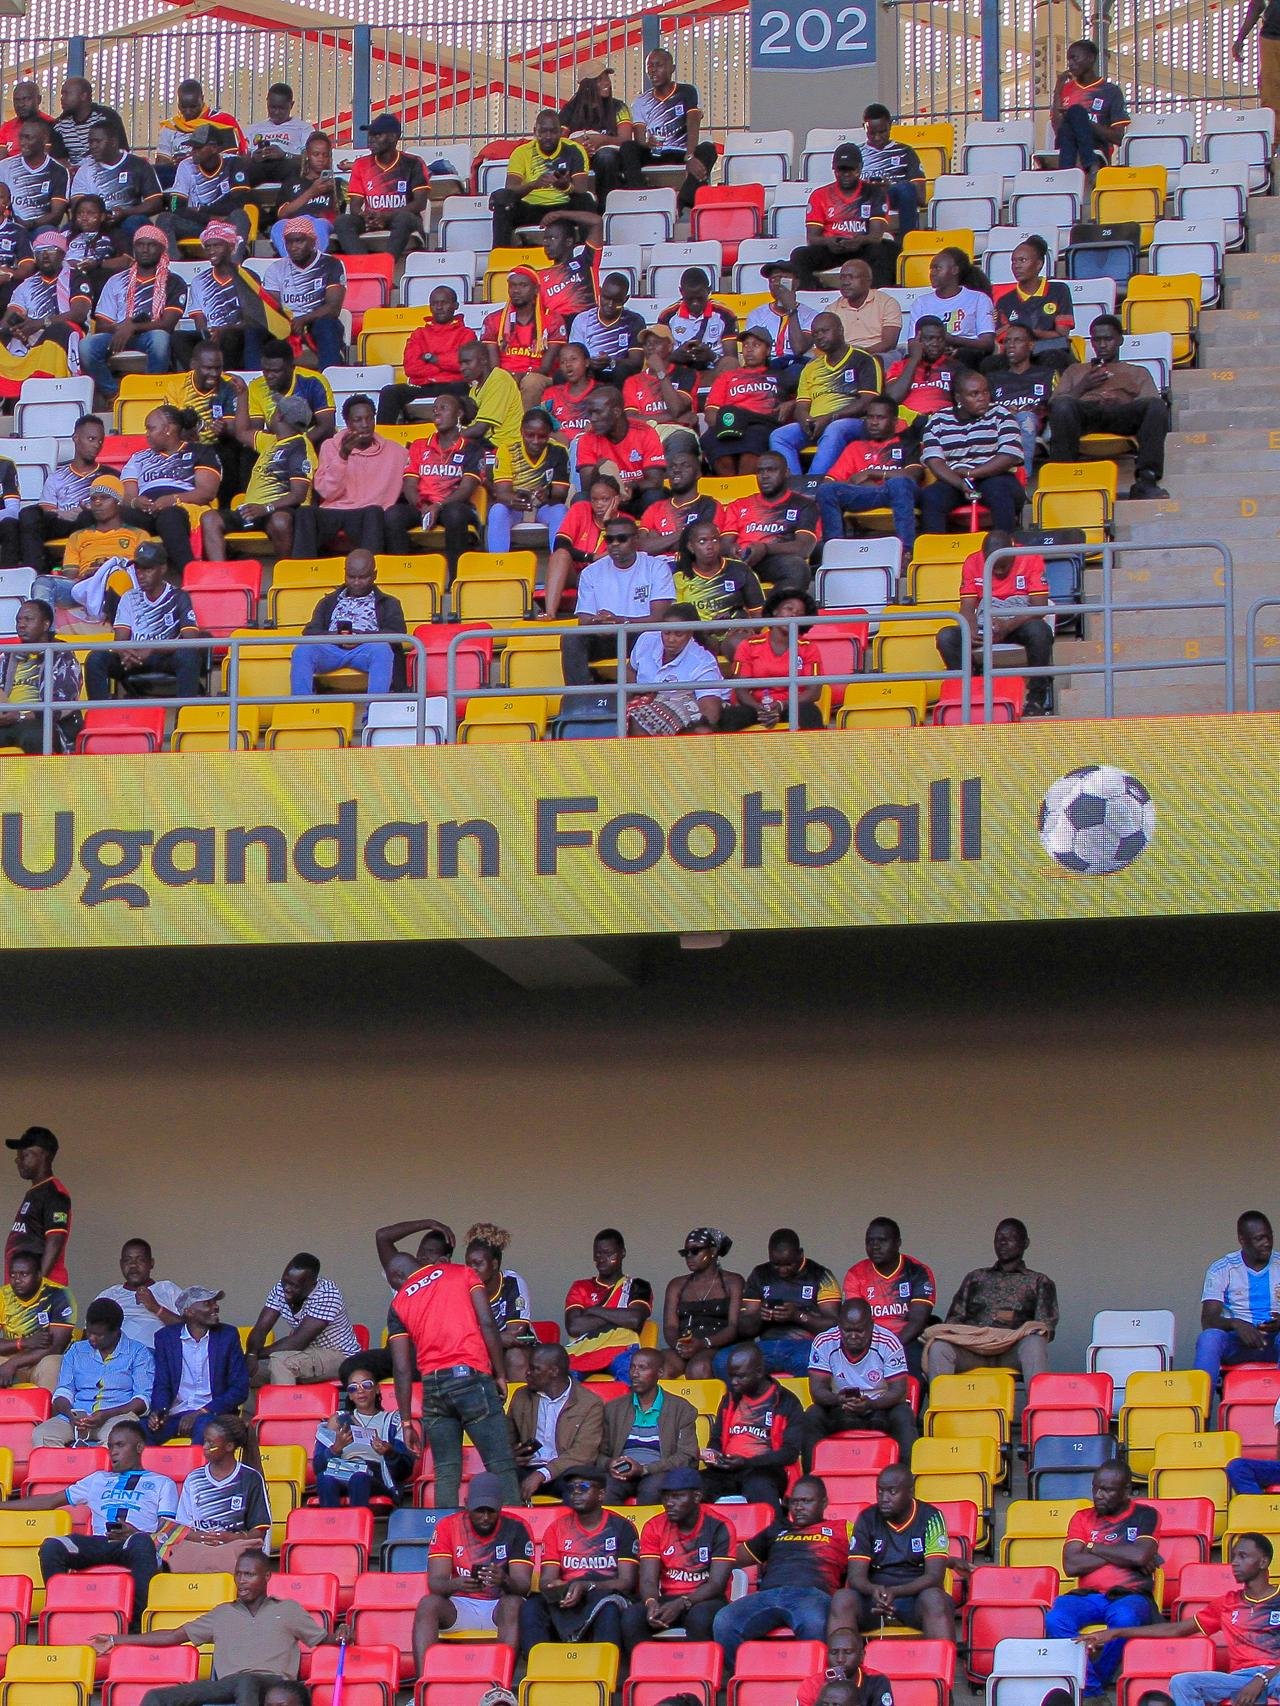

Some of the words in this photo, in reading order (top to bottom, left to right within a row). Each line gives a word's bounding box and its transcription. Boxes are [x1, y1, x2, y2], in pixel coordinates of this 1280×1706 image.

[758, 6, 869, 57] 202
[729, 383, 778, 396] UGANDA
[1241, 499, 1258, 517] D
[745, 523, 784, 533] UGANDA
[1184, 639, 1200, 659] B
[0, 797, 501, 910] Ugandan
[534, 776, 983, 876] Football
[405, 1268, 443, 1297] DEO
[563, 1556, 617, 1569] UGANDA
